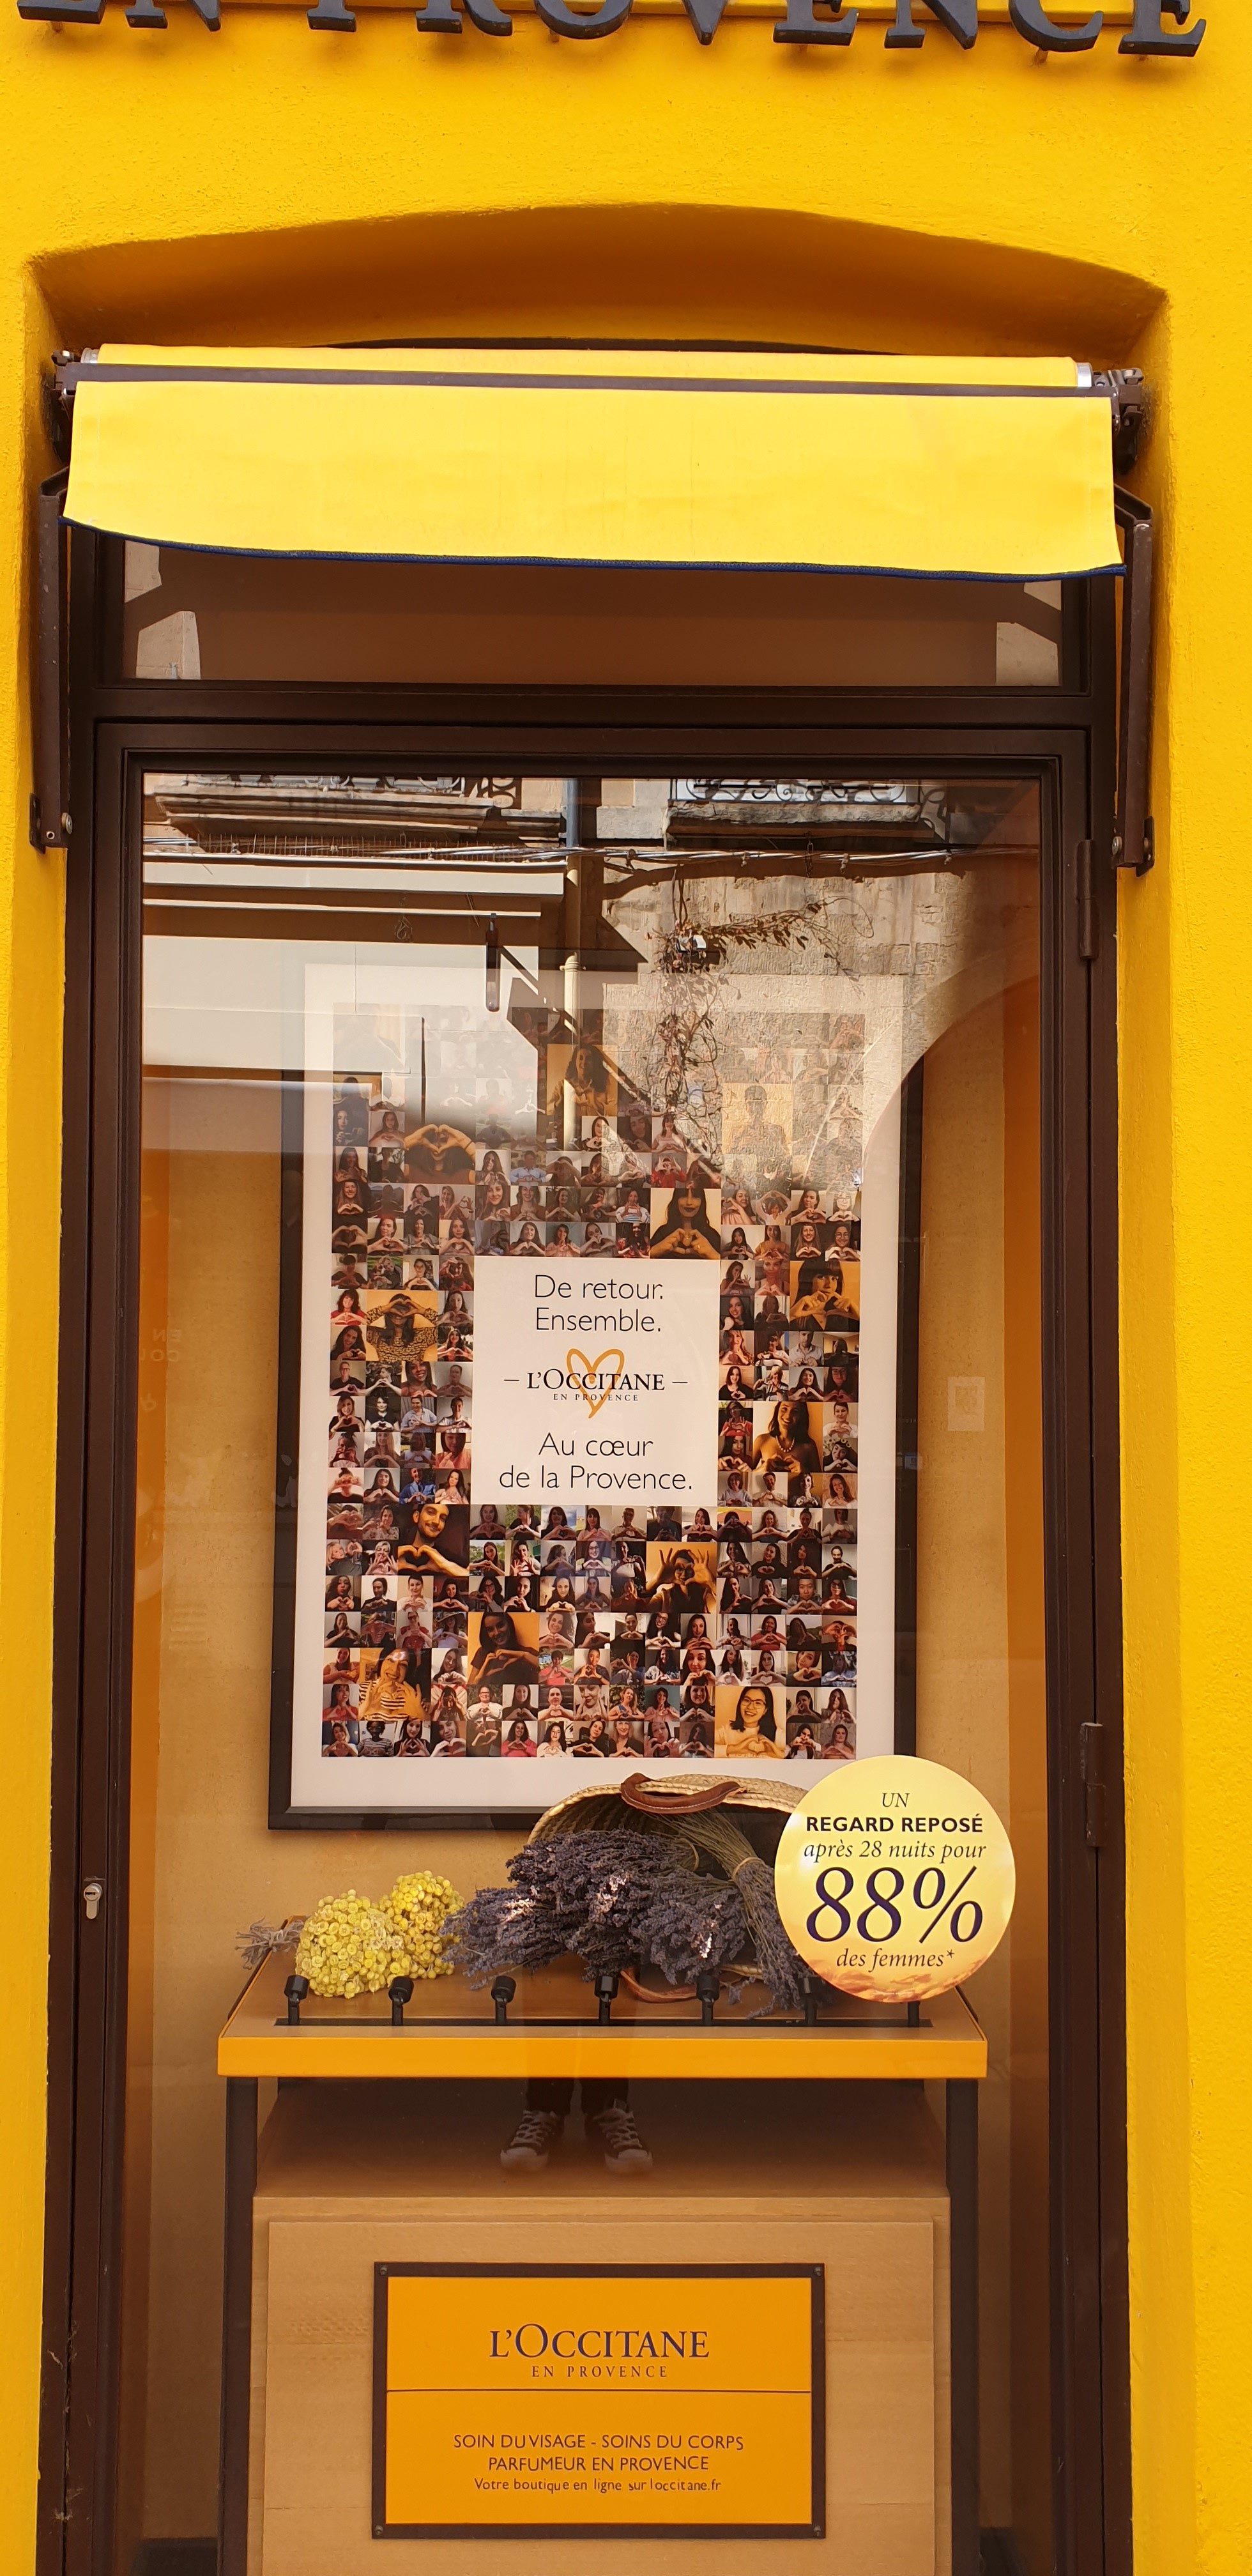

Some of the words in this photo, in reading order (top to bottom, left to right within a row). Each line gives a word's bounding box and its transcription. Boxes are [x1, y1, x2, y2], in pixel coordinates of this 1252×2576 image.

[535, 1275, 571, 1298] De
[583, 1279, 662, 1299] retour.
[537, 1308, 660, 1331] Ensemble.
[527, 1369, 664, 1390] L'OCCITANE
[538, 1432, 574, 1455] Au
[586, 1440, 653, 1456] cœur
[500, 1465, 530, 1487] de
[542, 1465, 559, 1488] la
[571, 1466, 691, 1489] Provence.
[883, 1793, 910, 1807] UN
[807, 1817, 894, 1831] REGARD
[902, 1814, 982, 1832] REPOSÉ
[804, 1839, 853, 1862] après
[859, 1841, 882, 1857] 28
[889, 1841, 935, 1857] nuits
[940, 1844, 986, 1864] pour
[807, 1866, 982, 1943] 88%
[837, 1948, 866, 1966] des
[489, 2324, 709, 2358] L'OCCITANE
[533, 2366, 553, 2377] EN
[568, 2366, 666, 2377] PROVENCE
[454, 2435, 494, 2448] SOIN
[501, 2435, 525, 2448] DU
[529, 2435, 585, 2448] VISAGE
[602, 2435, 650, 2448] SOINS
[657, 2435, 681, 2448] DU
[689, 2435, 743, 2450] CORPS
[489, 2457, 586, 2471] PARFUMEUR
[593, 2458, 613, 2471] EN
[621, 2456, 708, 2471] PROVENCE
[475, 2478, 508, 2489] Votre
[514, 2478, 569, 2494] boutique
[595, 2478, 622, 2493] ligne
[629, 2482, 646, 2490] sur
[651, 2478, 721, 2491] loccitane.fr
